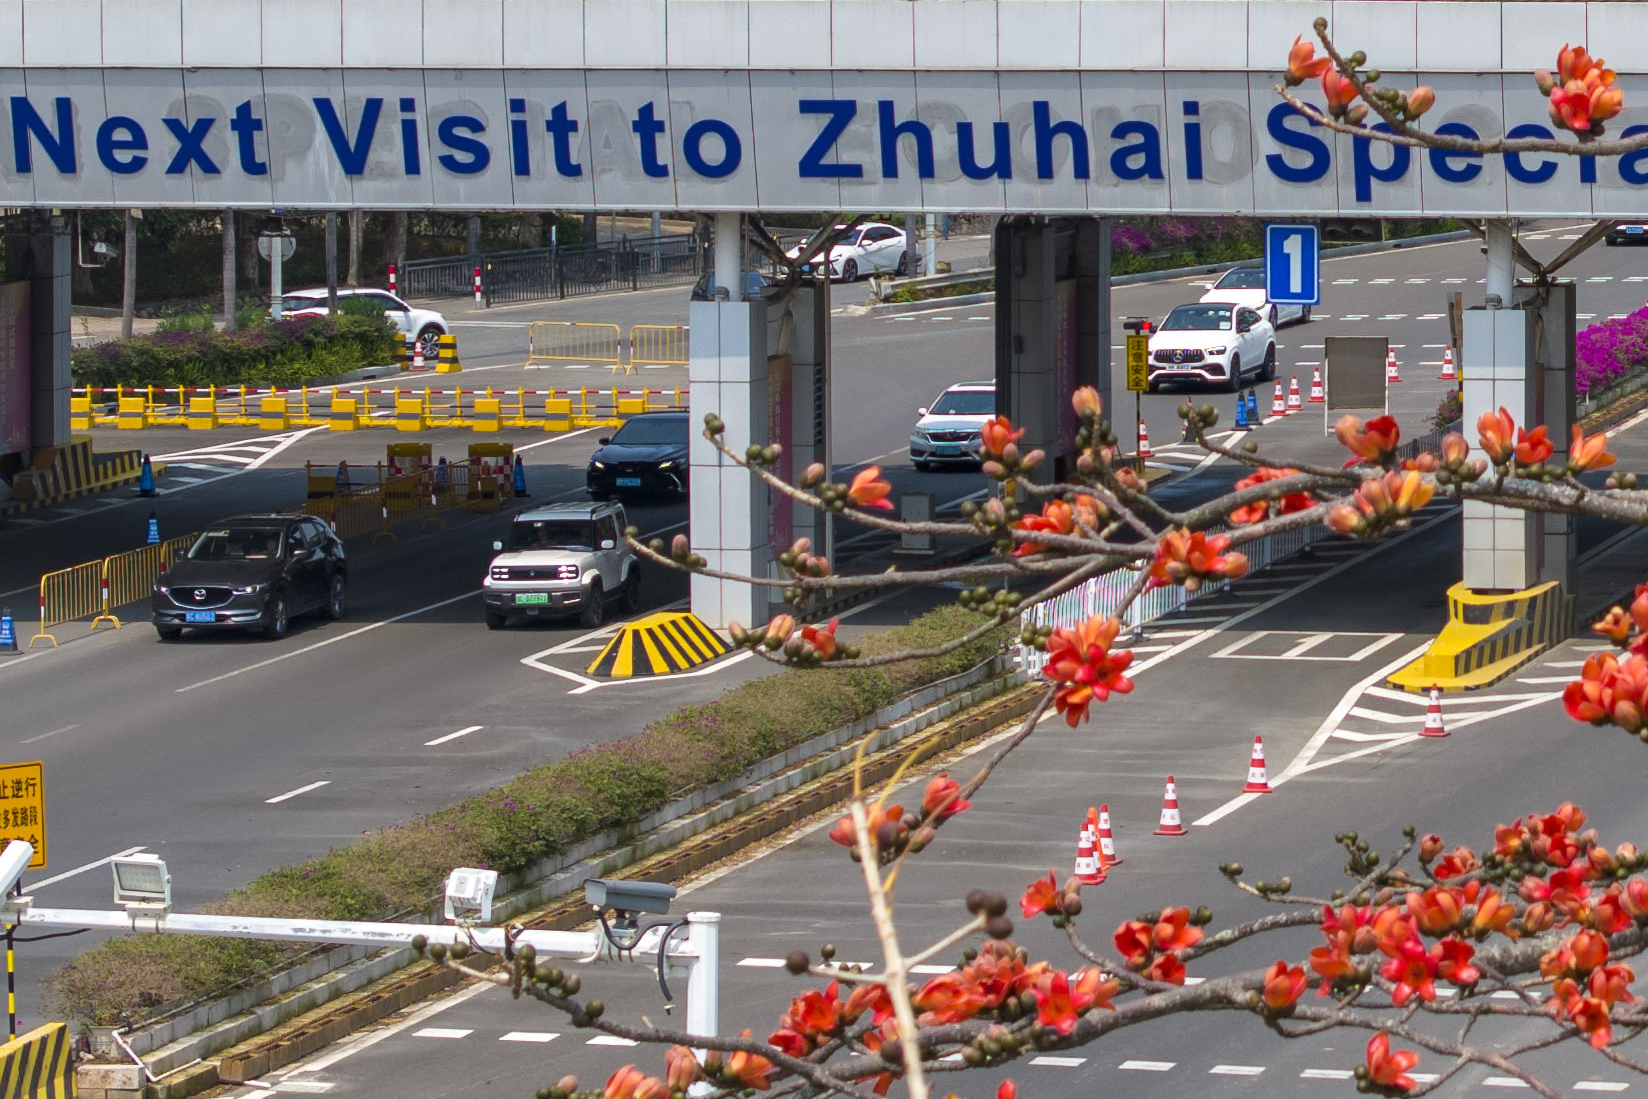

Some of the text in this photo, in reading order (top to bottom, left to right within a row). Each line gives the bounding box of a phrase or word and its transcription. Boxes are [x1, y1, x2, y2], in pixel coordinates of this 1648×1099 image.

[11, 96, 267, 176] Next
[313, 97, 581, 177] Visit
[633, 101, 741, 178] to
[799, 99, 1203, 180] Zhuhai
[1283, 234, 1302, 294] 1
[1131, 339, 1145, 388] 注意安全
[0, 805, 38, 829] 多发路段
